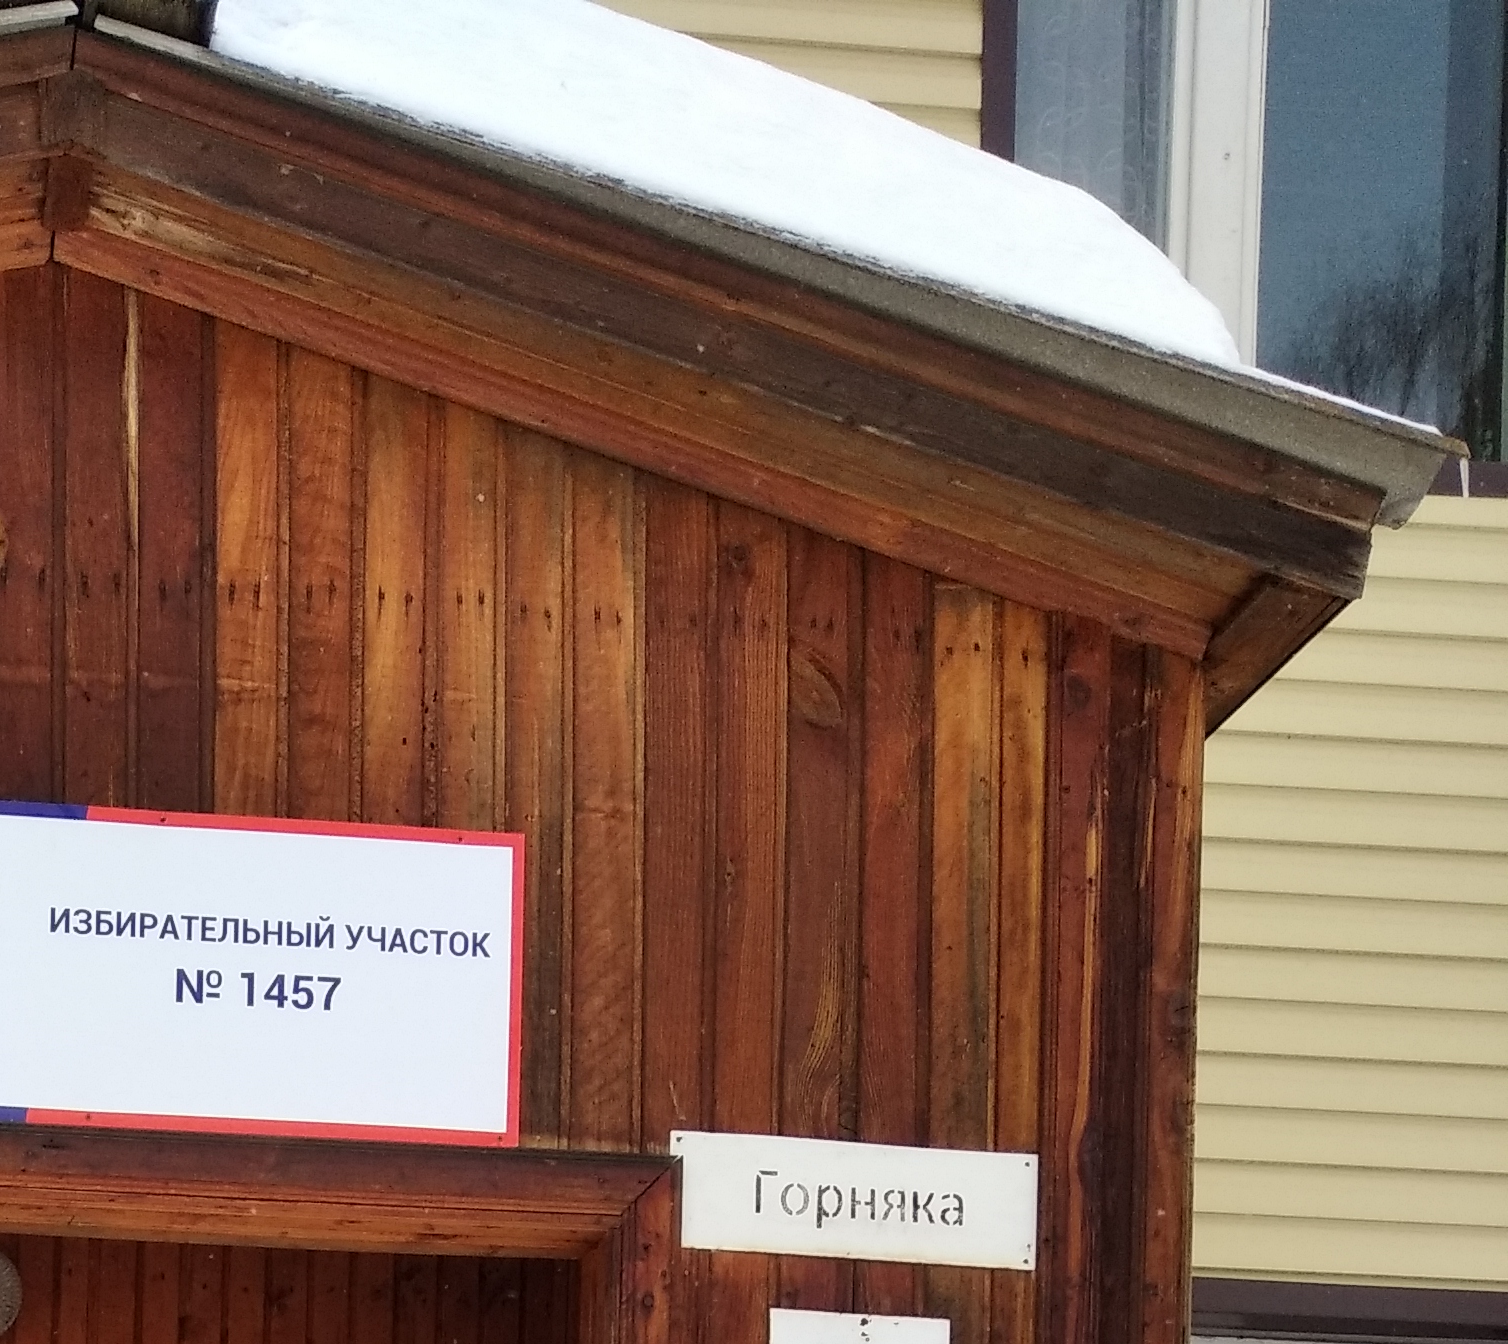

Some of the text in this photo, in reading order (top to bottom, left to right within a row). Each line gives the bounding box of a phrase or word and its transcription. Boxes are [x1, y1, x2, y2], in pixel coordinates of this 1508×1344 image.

[49, 907, 491, 958] ИЗБИРАТЕЛЬНЫЙ УЧАСТОК
[175, 968, 342, 1011] № 1457
[754, 1169, 965, 1230] Горняка
